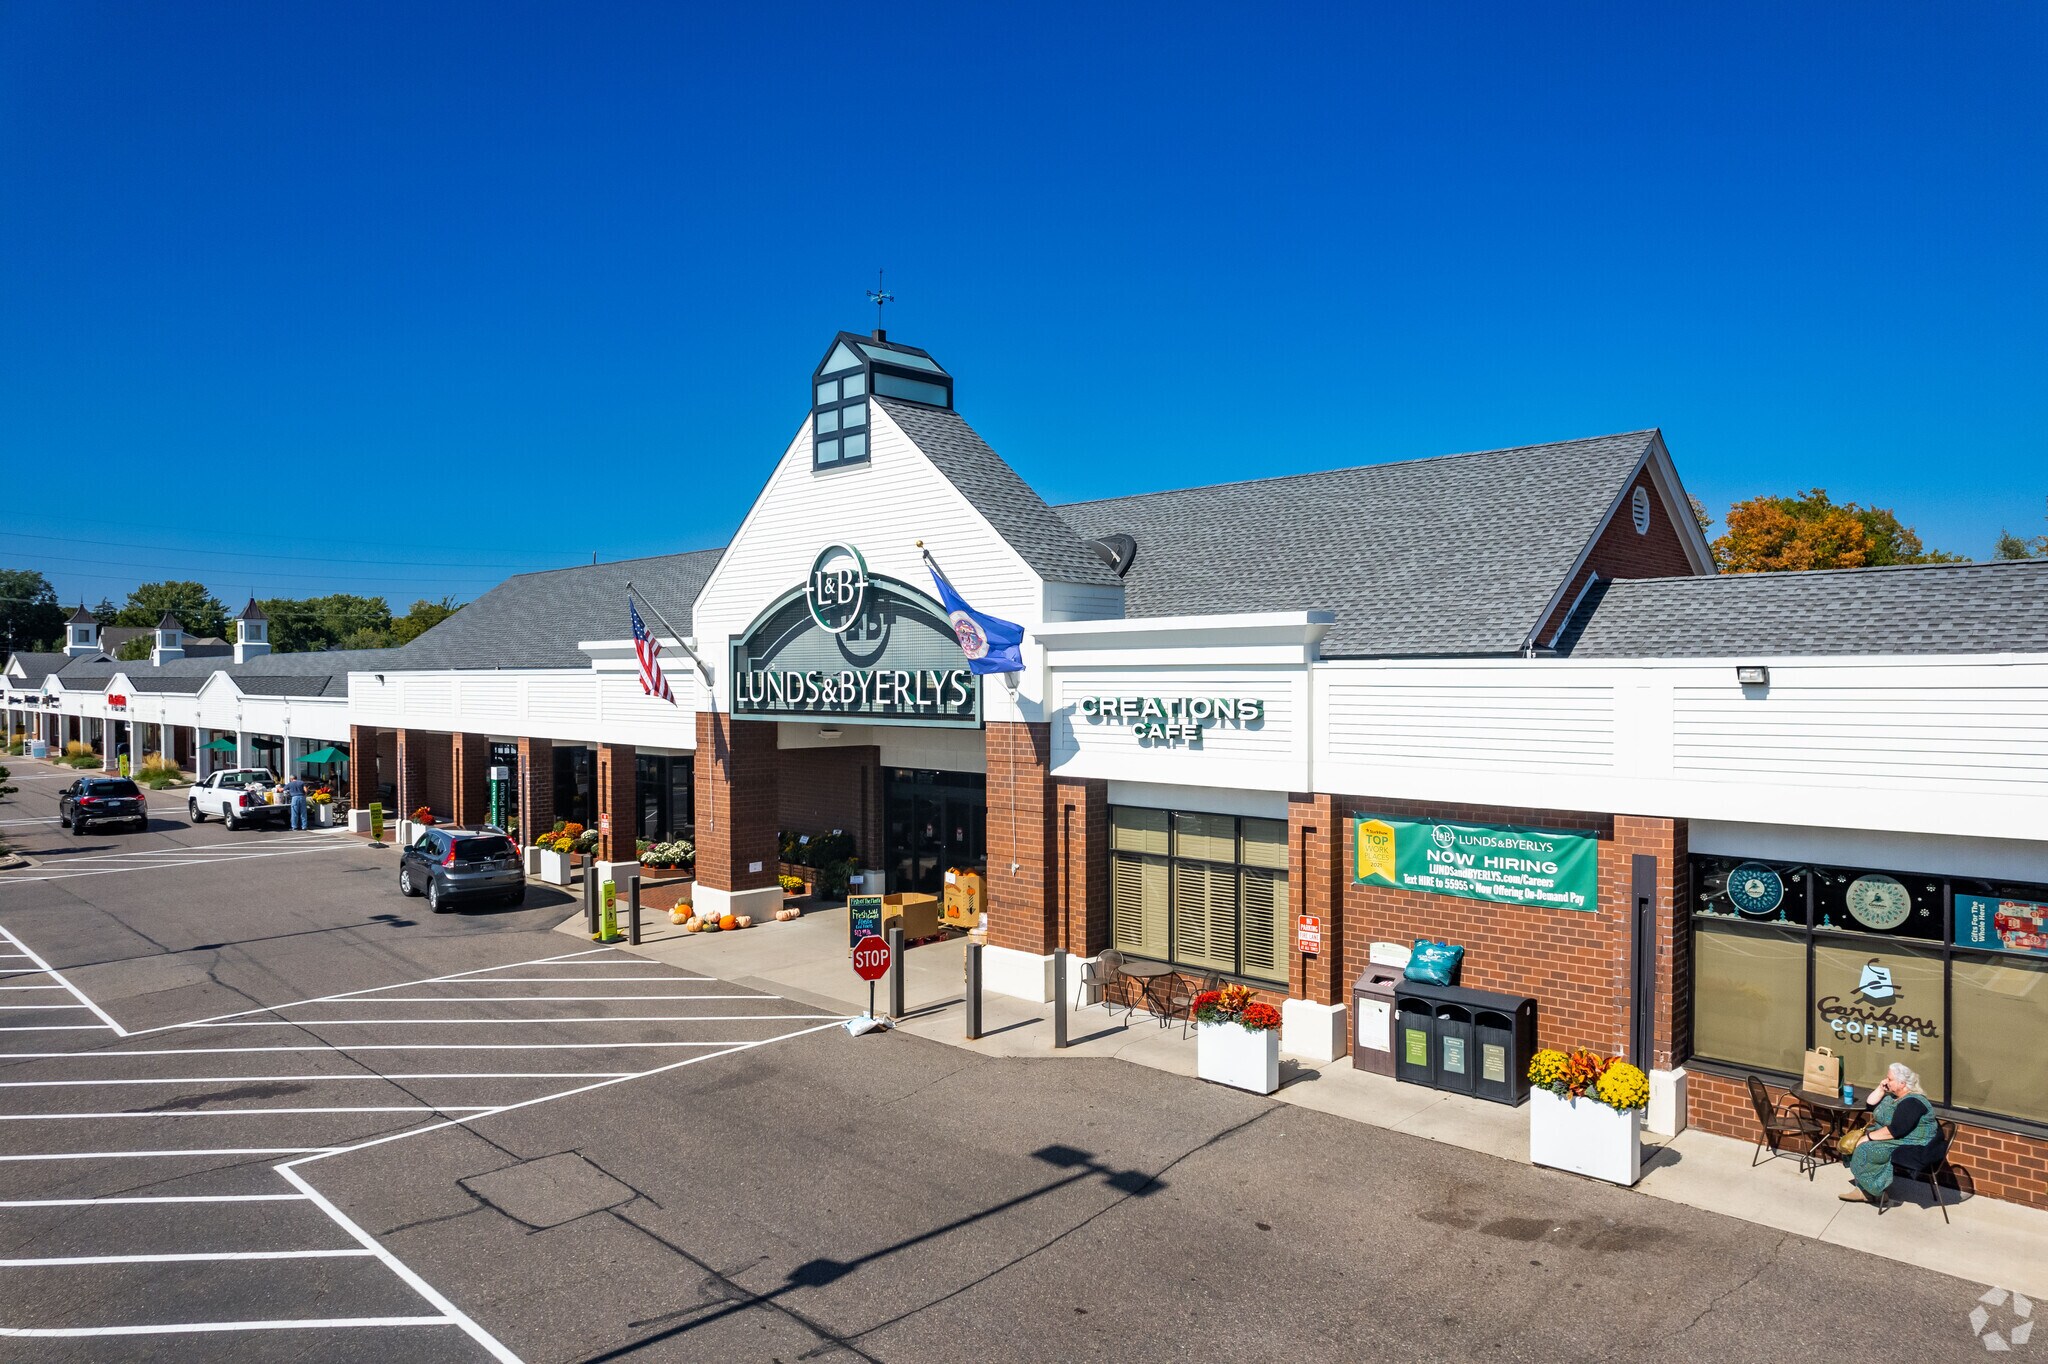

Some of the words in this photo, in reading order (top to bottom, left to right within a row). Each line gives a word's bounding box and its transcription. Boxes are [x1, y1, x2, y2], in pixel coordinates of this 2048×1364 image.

[815, 568, 854, 605] L&B
[736, 669, 968, 707] LUNDS&BYERLYS
[1080, 695, 1260, 720] CREATIONS
[1132, 722, 1198, 740] CAFE
[1366, 834, 1389, 846] TOP
[1435, 827, 1452, 842] L&B
[1459, 834, 1554, 853] LUNDS&BYERLYS
[1365, 852, 1390, 861] PLACES
[1366, 845, 1389, 854] WORK
[1426, 849, 1475, 866] NOW
[1484, 856, 1558, 874] HIRING
[1429, 863, 1554, 888] LUNDSandBYERLYS.com/Careers
[1403, 873, 1418, 885] Text
[1418, 875, 1435, 887] HIRE
[1435, 877, 1444, 889] to
[1444, 878, 1468, 891] 55955
[1475, 882, 1493, 895] Now
[1493, 884, 1524, 900] Offering
[1524, 887, 1569, 903] On-Demand
[1569, 891, 1585, 907] Pay
[1970, 901, 1979, 913] The
[1978, 903, 1986, 921] Herd.
[1300, 924, 1318, 932] PARKING
[1970, 914, 1979, 927] For
[1970, 928, 1979, 942] Gifts
[1978, 921, 1986, 942] Whole
[855, 949, 889, 968] STOP
[1817, 996, 1937, 1030] Caribou
[1830, 1018, 1918, 1045] COFFEE
